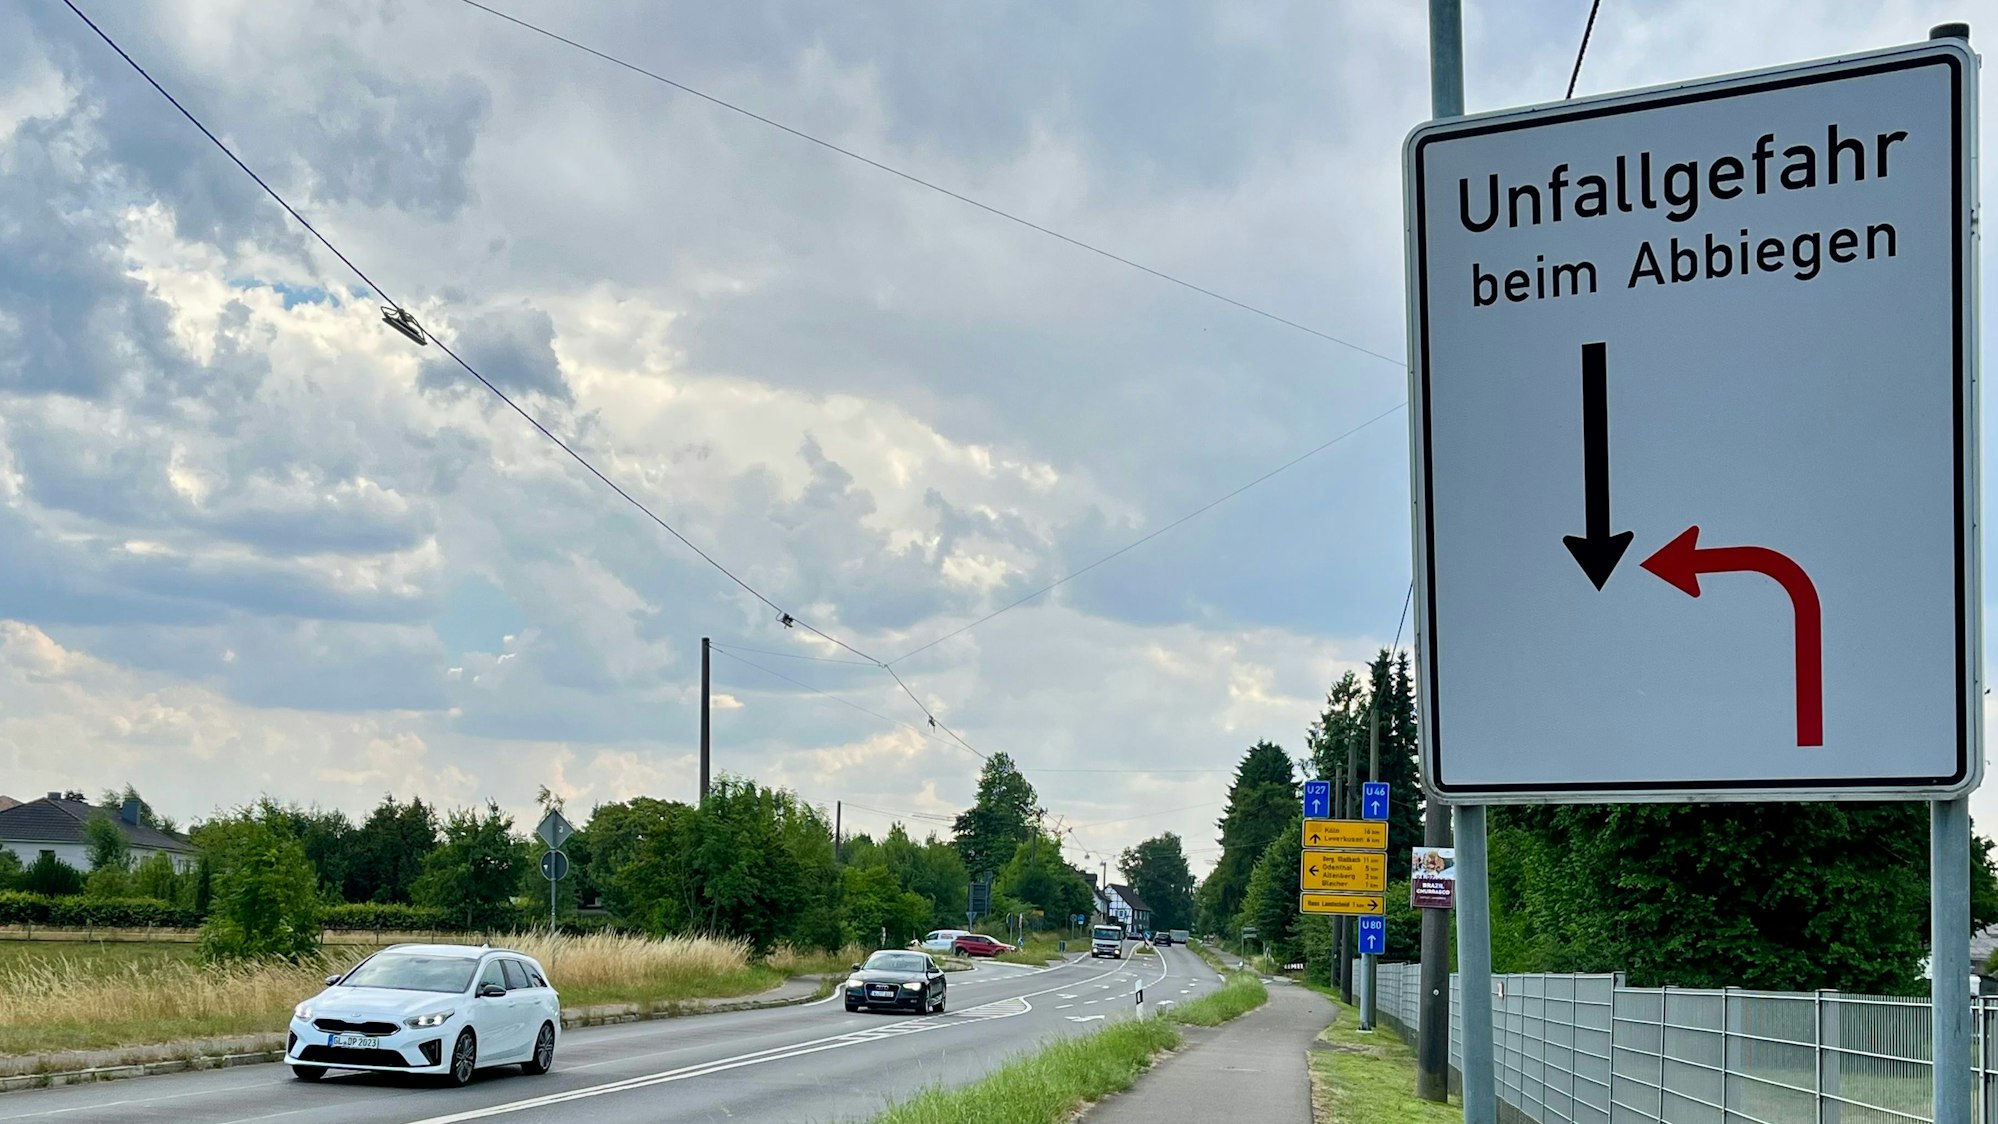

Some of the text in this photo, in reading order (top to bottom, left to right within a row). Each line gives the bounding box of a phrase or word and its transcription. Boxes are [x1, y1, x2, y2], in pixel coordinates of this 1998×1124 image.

[1458, 124, 1909, 233] Unfallgefahr
[1472, 221, 1898, 307] beim Abbiegen
[1323, 872, 1356, 880] Altenberg
[1422, 882, 1445, 890] BRAZIL
[1416, 888, 1451, 896] CHURRASCO
[358, 1038, 377, 1047] 2023
